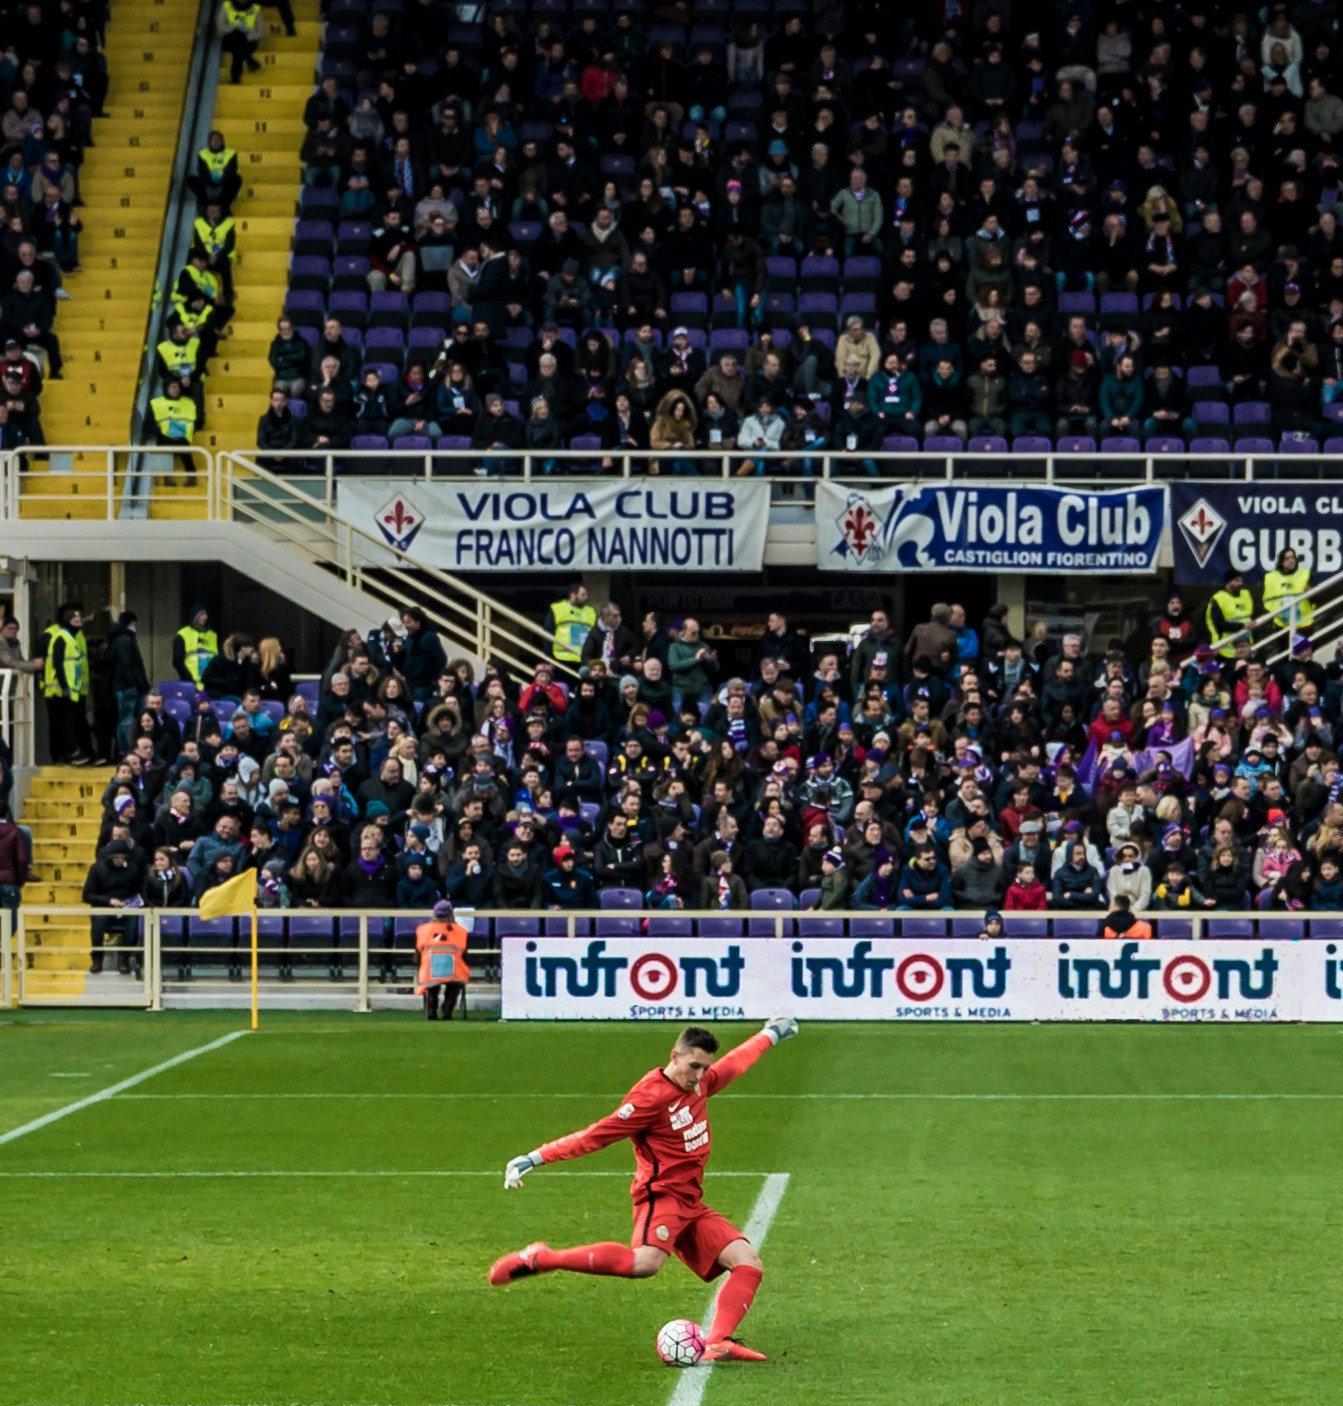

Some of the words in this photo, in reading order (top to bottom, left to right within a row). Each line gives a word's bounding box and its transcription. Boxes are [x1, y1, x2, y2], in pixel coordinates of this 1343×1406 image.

[457, 491, 597, 521] VIOLA
[614, 490, 736, 520] CLUB
[935, 491, 1043, 545] Viola
[1057, 492, 1151, 547] Club
[1237, 496, 1306, 515] VIOLA
[456, 527, 577, 566] FRANCO
[586, 527, 735, 566] NANNOTTI
[944, 549, 1044, 566] CASTIGLION
[1047, 551, 1148, 566] FIORENTINO
[525, 940, 746, 1002] infront
[791, 940, 1012, 1002] infront
[1057, 942, 1279, 1004] infront
[629, 1004, 683, 1018] SPORTS
[687, 1005, 698, 1017] &
[701, 1005, 746, 1018] MEDIA
[895, 1006, 949, 1018] SPORTS
[954, 1006, 963, 1017] &
[966, 1006, 1012, 1018] MEDIA
[1161, 1007, 1216, 1019] SPORTS
[1220, 1008, 1230, 1019] &
[1234, 1008, 1279, 1019] MEDIA
